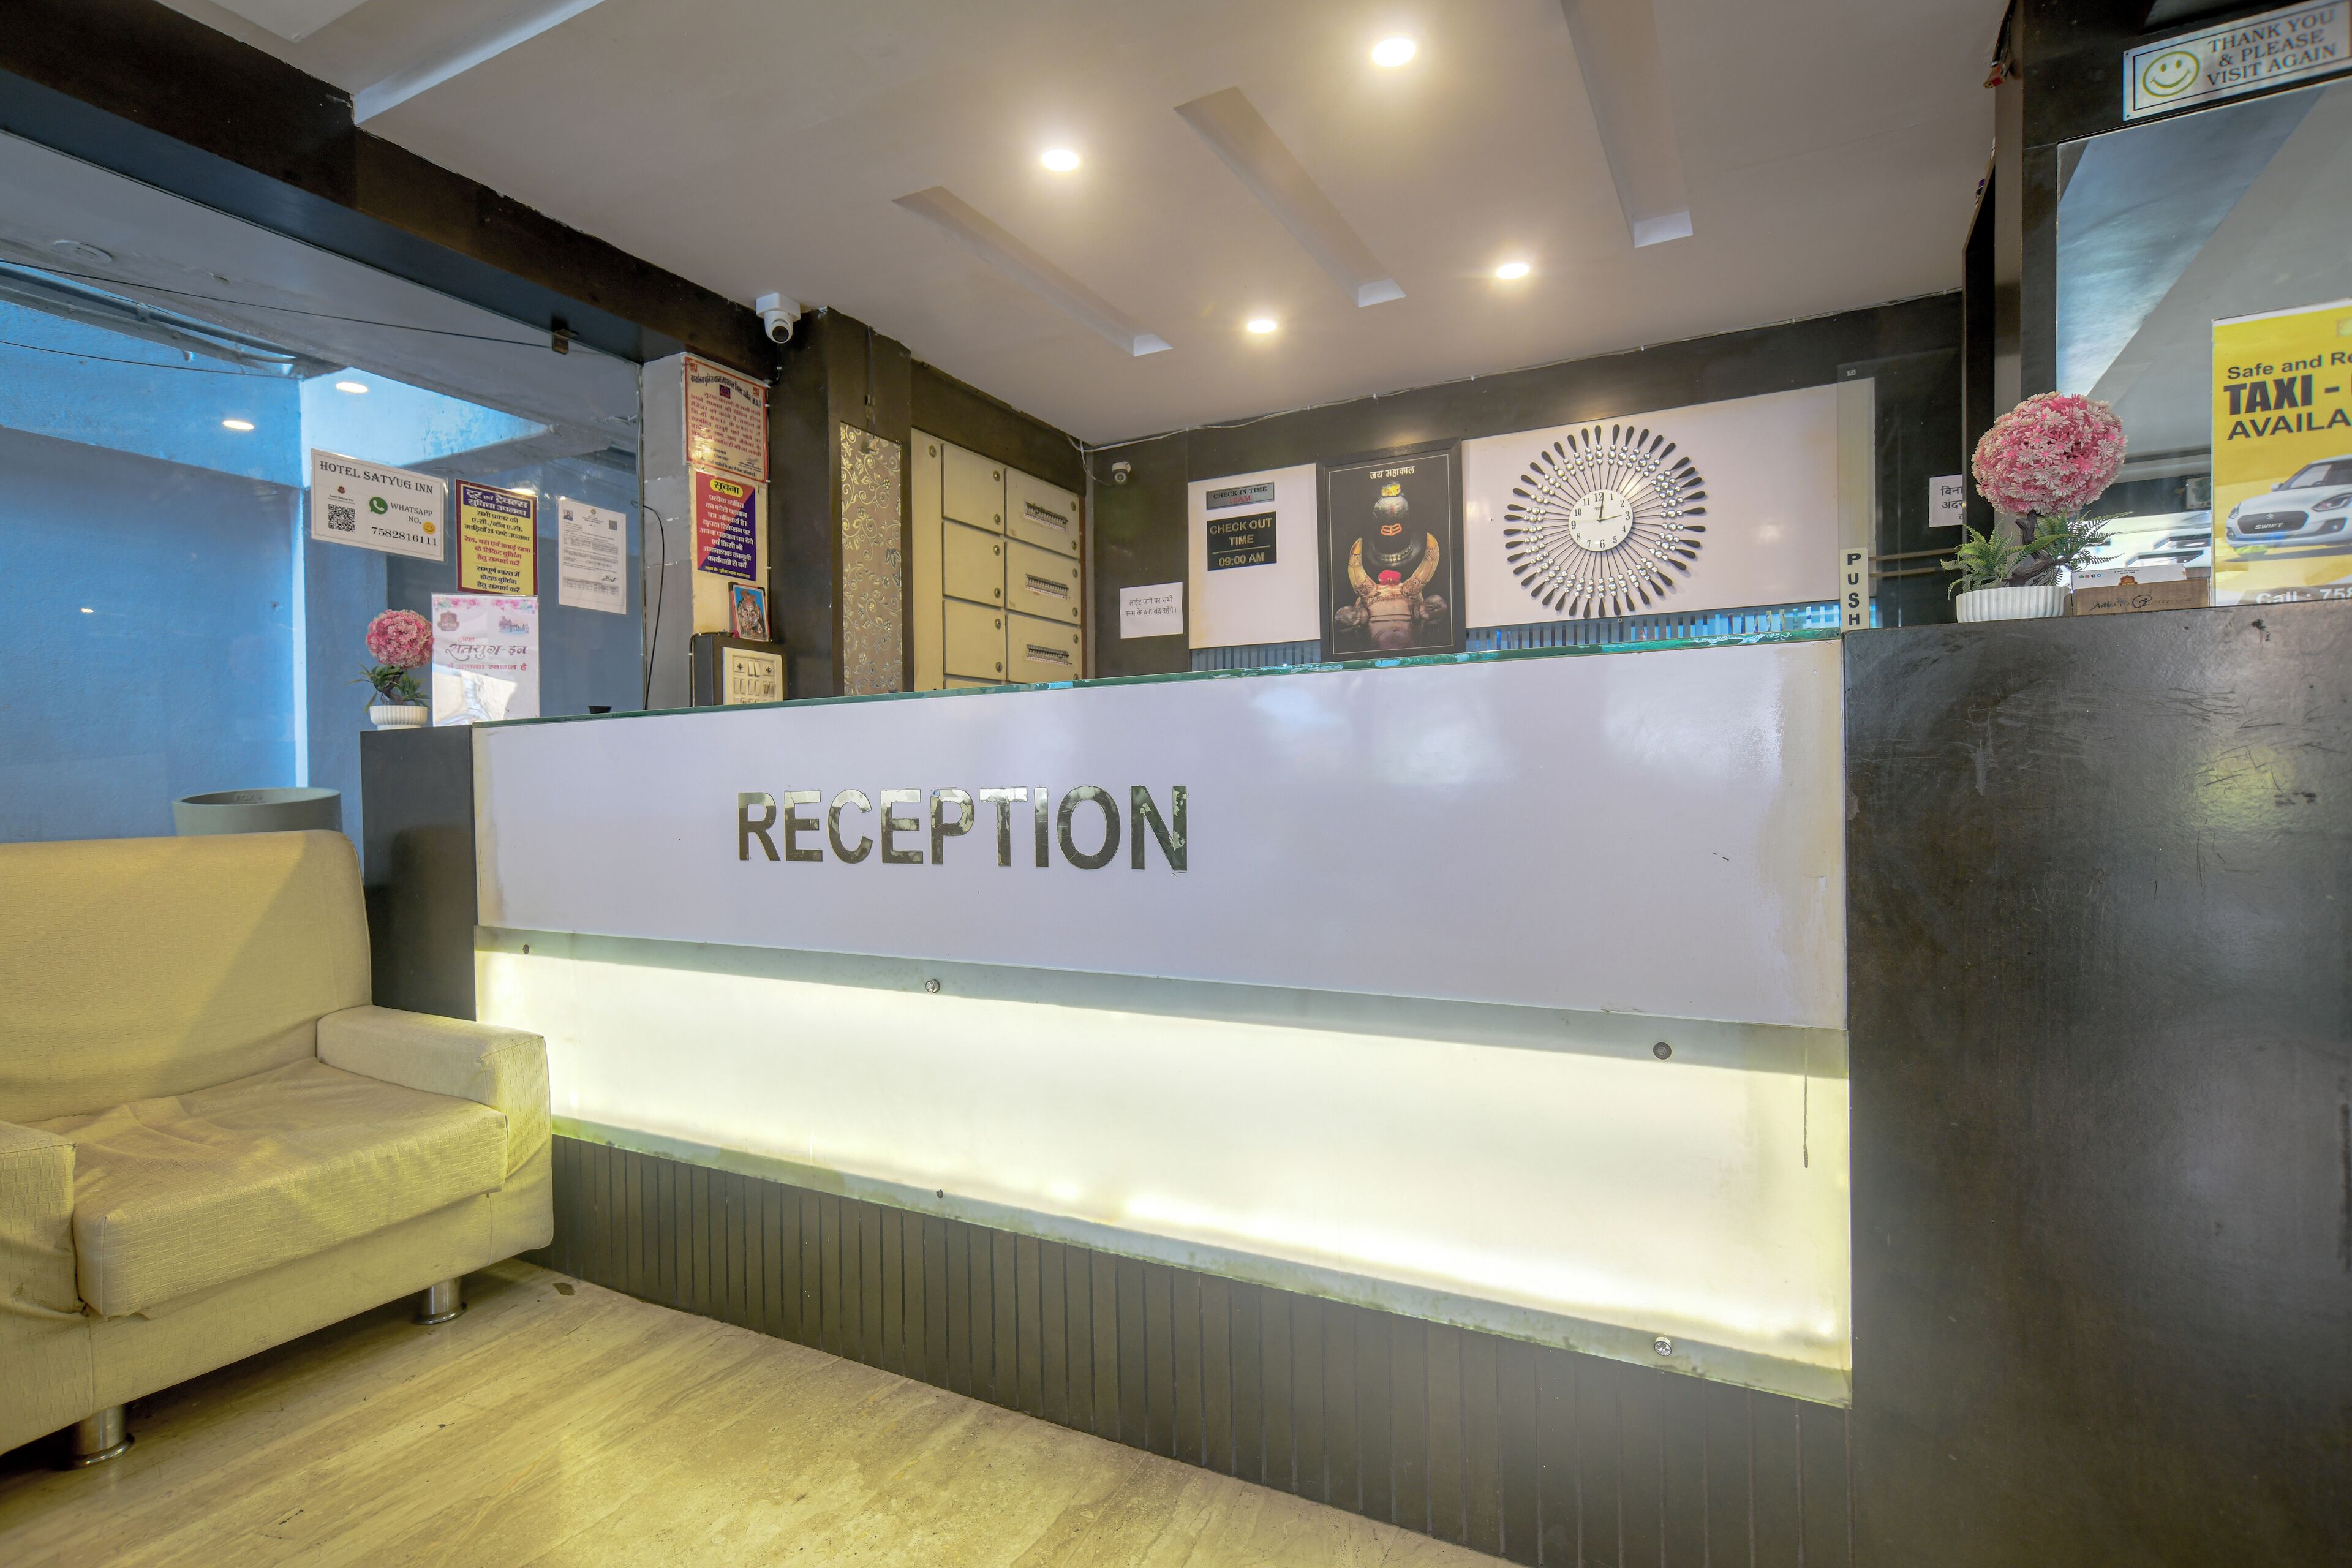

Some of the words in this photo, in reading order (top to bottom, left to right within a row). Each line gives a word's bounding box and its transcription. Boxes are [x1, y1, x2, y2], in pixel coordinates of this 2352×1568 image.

[2208, 24, 2279, 53] THANK
[2286, 9, 2335, 32] YOU
[2219, 54, 2232, 67] &
[2240, 29, 2324, 62] PLEASE
[2207, 62, 2261, 85] VISIT
[2267, 43, 2337, 73] AGAIN
[2228, 363, 2274, 379] Safe
[2282, 355, 2323, 372] and
[2223, 375, 2312, 415] TAXI
[320, 461, 360, 479] HOTEL
[363, 472, 412, 489] SATYUG
[415, 483, 433, 494] INN
[1370, 471, 1382, 480] जय
[1386, 466, 1415, 478] महाकाल
[466, 489, 482, 499] टूर
[715, 481, 739, 494] सूचना
[1213, 490, 1237, 499] CHECK
[1594, 492, 1604, 502] 12
[391, 503, 432, 516] WHATSAPP
[468, 499, 496, 509] सुविधा
[497, 505, 526, 516] उपलब्ध
[729, 508, 747, 518] पहचान
[718, 514, 739, 524] अनिवार्य
[1625, 511, 1630, 520] 3
[1210, 521, 1247, 535] CHECK
[1250, 518, 1273, 529] OUT
[1571, 521, 1576, 529] 9
[372, 527, 437, 546] 7582816111
[717, 531, 735, 540] पहचान
[1229, 534, 1254, 546] TIME
[720, 540, 735, 549] किसी
[1600, 539, 1605, 548] 6
[704, 546, 731, 556] अनावश्यक
[733, 552, 751, 562] कानूनी
[707, 556, 731, 565] कार्यवाही
[1219, 555, 1246, 567] 09:00
[1249, 552, 1264, 562] AM
[477, 581, 487, 589] हेतु
[1847, 552, 1861, 625] PUSH
[737, 785, 1188, 872] RECEPTION
